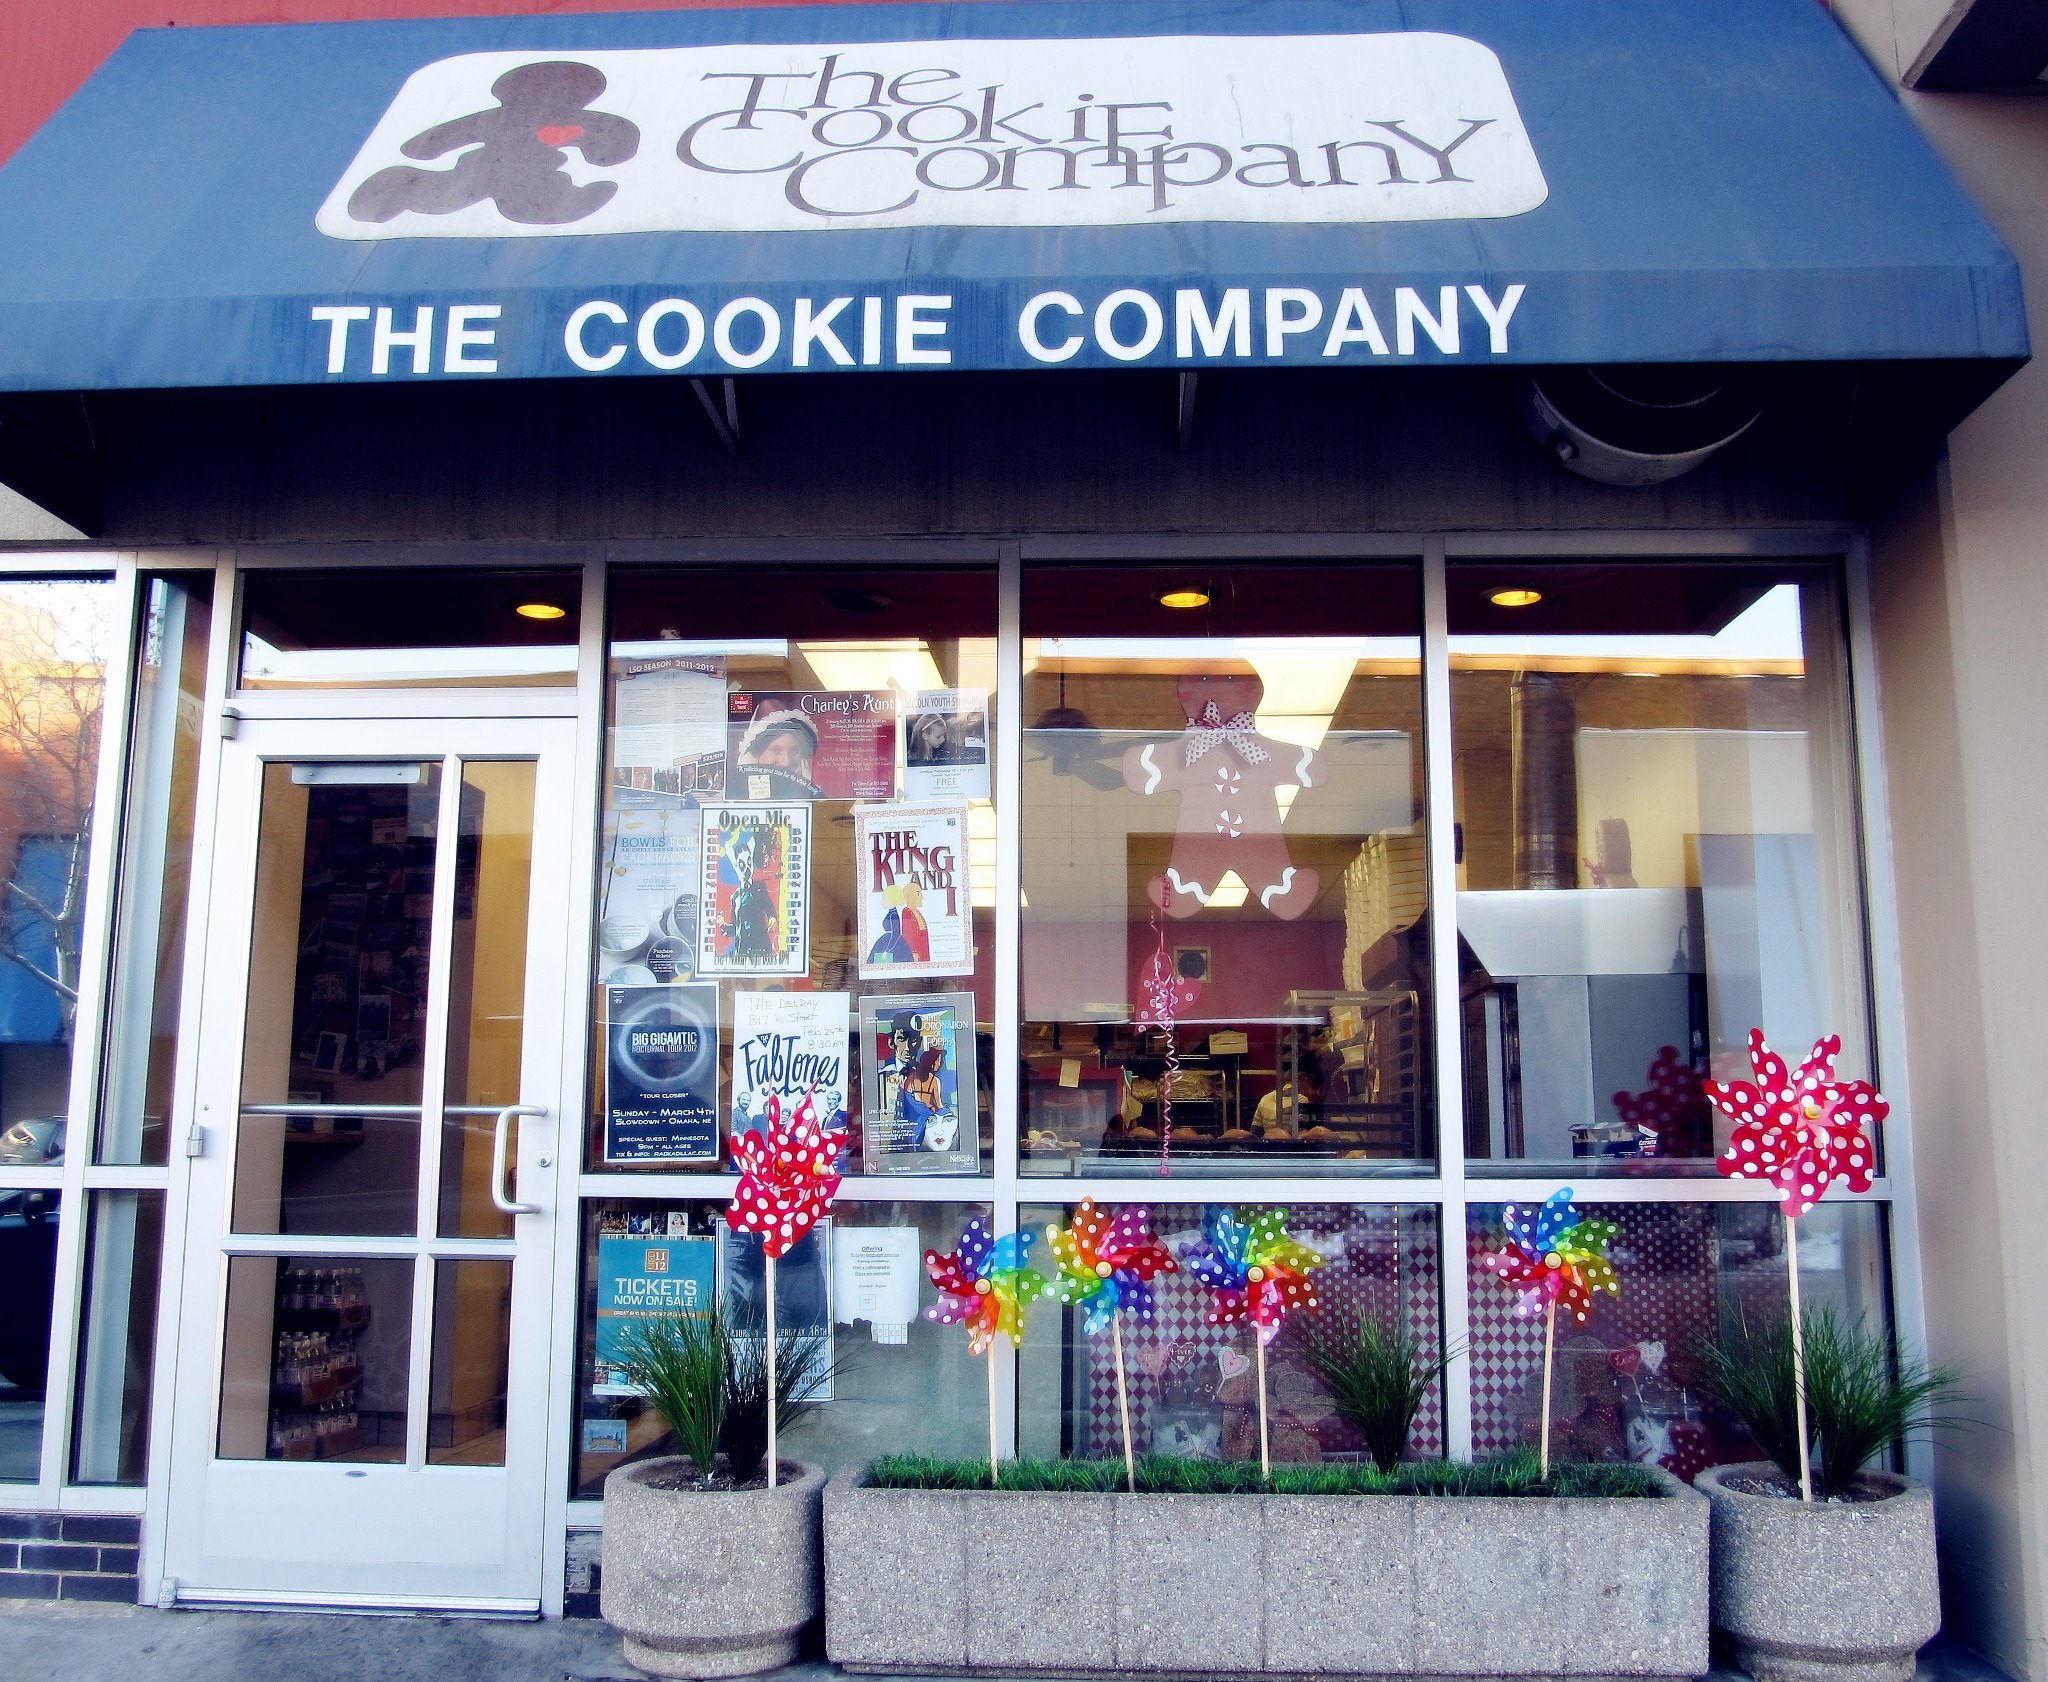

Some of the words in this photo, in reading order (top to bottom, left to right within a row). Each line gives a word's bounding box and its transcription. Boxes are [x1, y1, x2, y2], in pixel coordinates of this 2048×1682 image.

[701, 53, 962, 130] The
[311, 304, 502, 375] THE
[564, 294, 953, 372] COOKIE
[1018, 284, 1526, 363] COMPANY
[629, 666, 643, 674] LSO
[644, 660, 672, 671] SEASON
[675, 660, 715, 672] 2011-2012
[800, 693, 859, 715] Charley's
[863, 693, 895, 713] Aunt
[930, 697, 951, 708] YOUTH
[936, 777, 957, 786] FREE
[719, 810, 760, 828] Open
[765, 810, 792, 828] Mic
[621, 837, 666, 848] BOWLS
[669, 836, 696, 847] FOR
[868, 830, 918, 851] THE
[871, 846, 956, 893] KING
[911, 870, 952, 891] AND
[946, 887, 958, 917] I
[744, 994, 773, 1012] THE
[779, 997, 819, 1015] DELRAY
[749, 1013, 769, 1026] 817
[909, 1013, 969, 1032] CORONATION
[801, 1025, 822, 1037] Feb
[632, 1032, 649, 1046] BIG
[650, 1031, 698, 1046] GIGANTIC
[807, 1038, 832, 1051] 8:30
[632, 1045, 665, 1054] NOCTURNAL
[667, 1045, 682, 1053] TOUR
[684, 1044, 698, 1053] 2012
[739, 1033, 841, 1098] FabTones
[612, 1109, 650, 1117] SUNDAY
[660, 1108, 694, 1116] MARCH
[615, 1118, 660, 1126] SLOWDOWN
[655, 1251, 666, 1261] 11
[655, 1261, 667, 1270] 12
[614, 1277, 697, 1296] TICKETS
[614, 1295, 643, 1305] NOW
[645, 1296, 662, 1306] ON
[665, 1296, 698, 1307] SALE!
